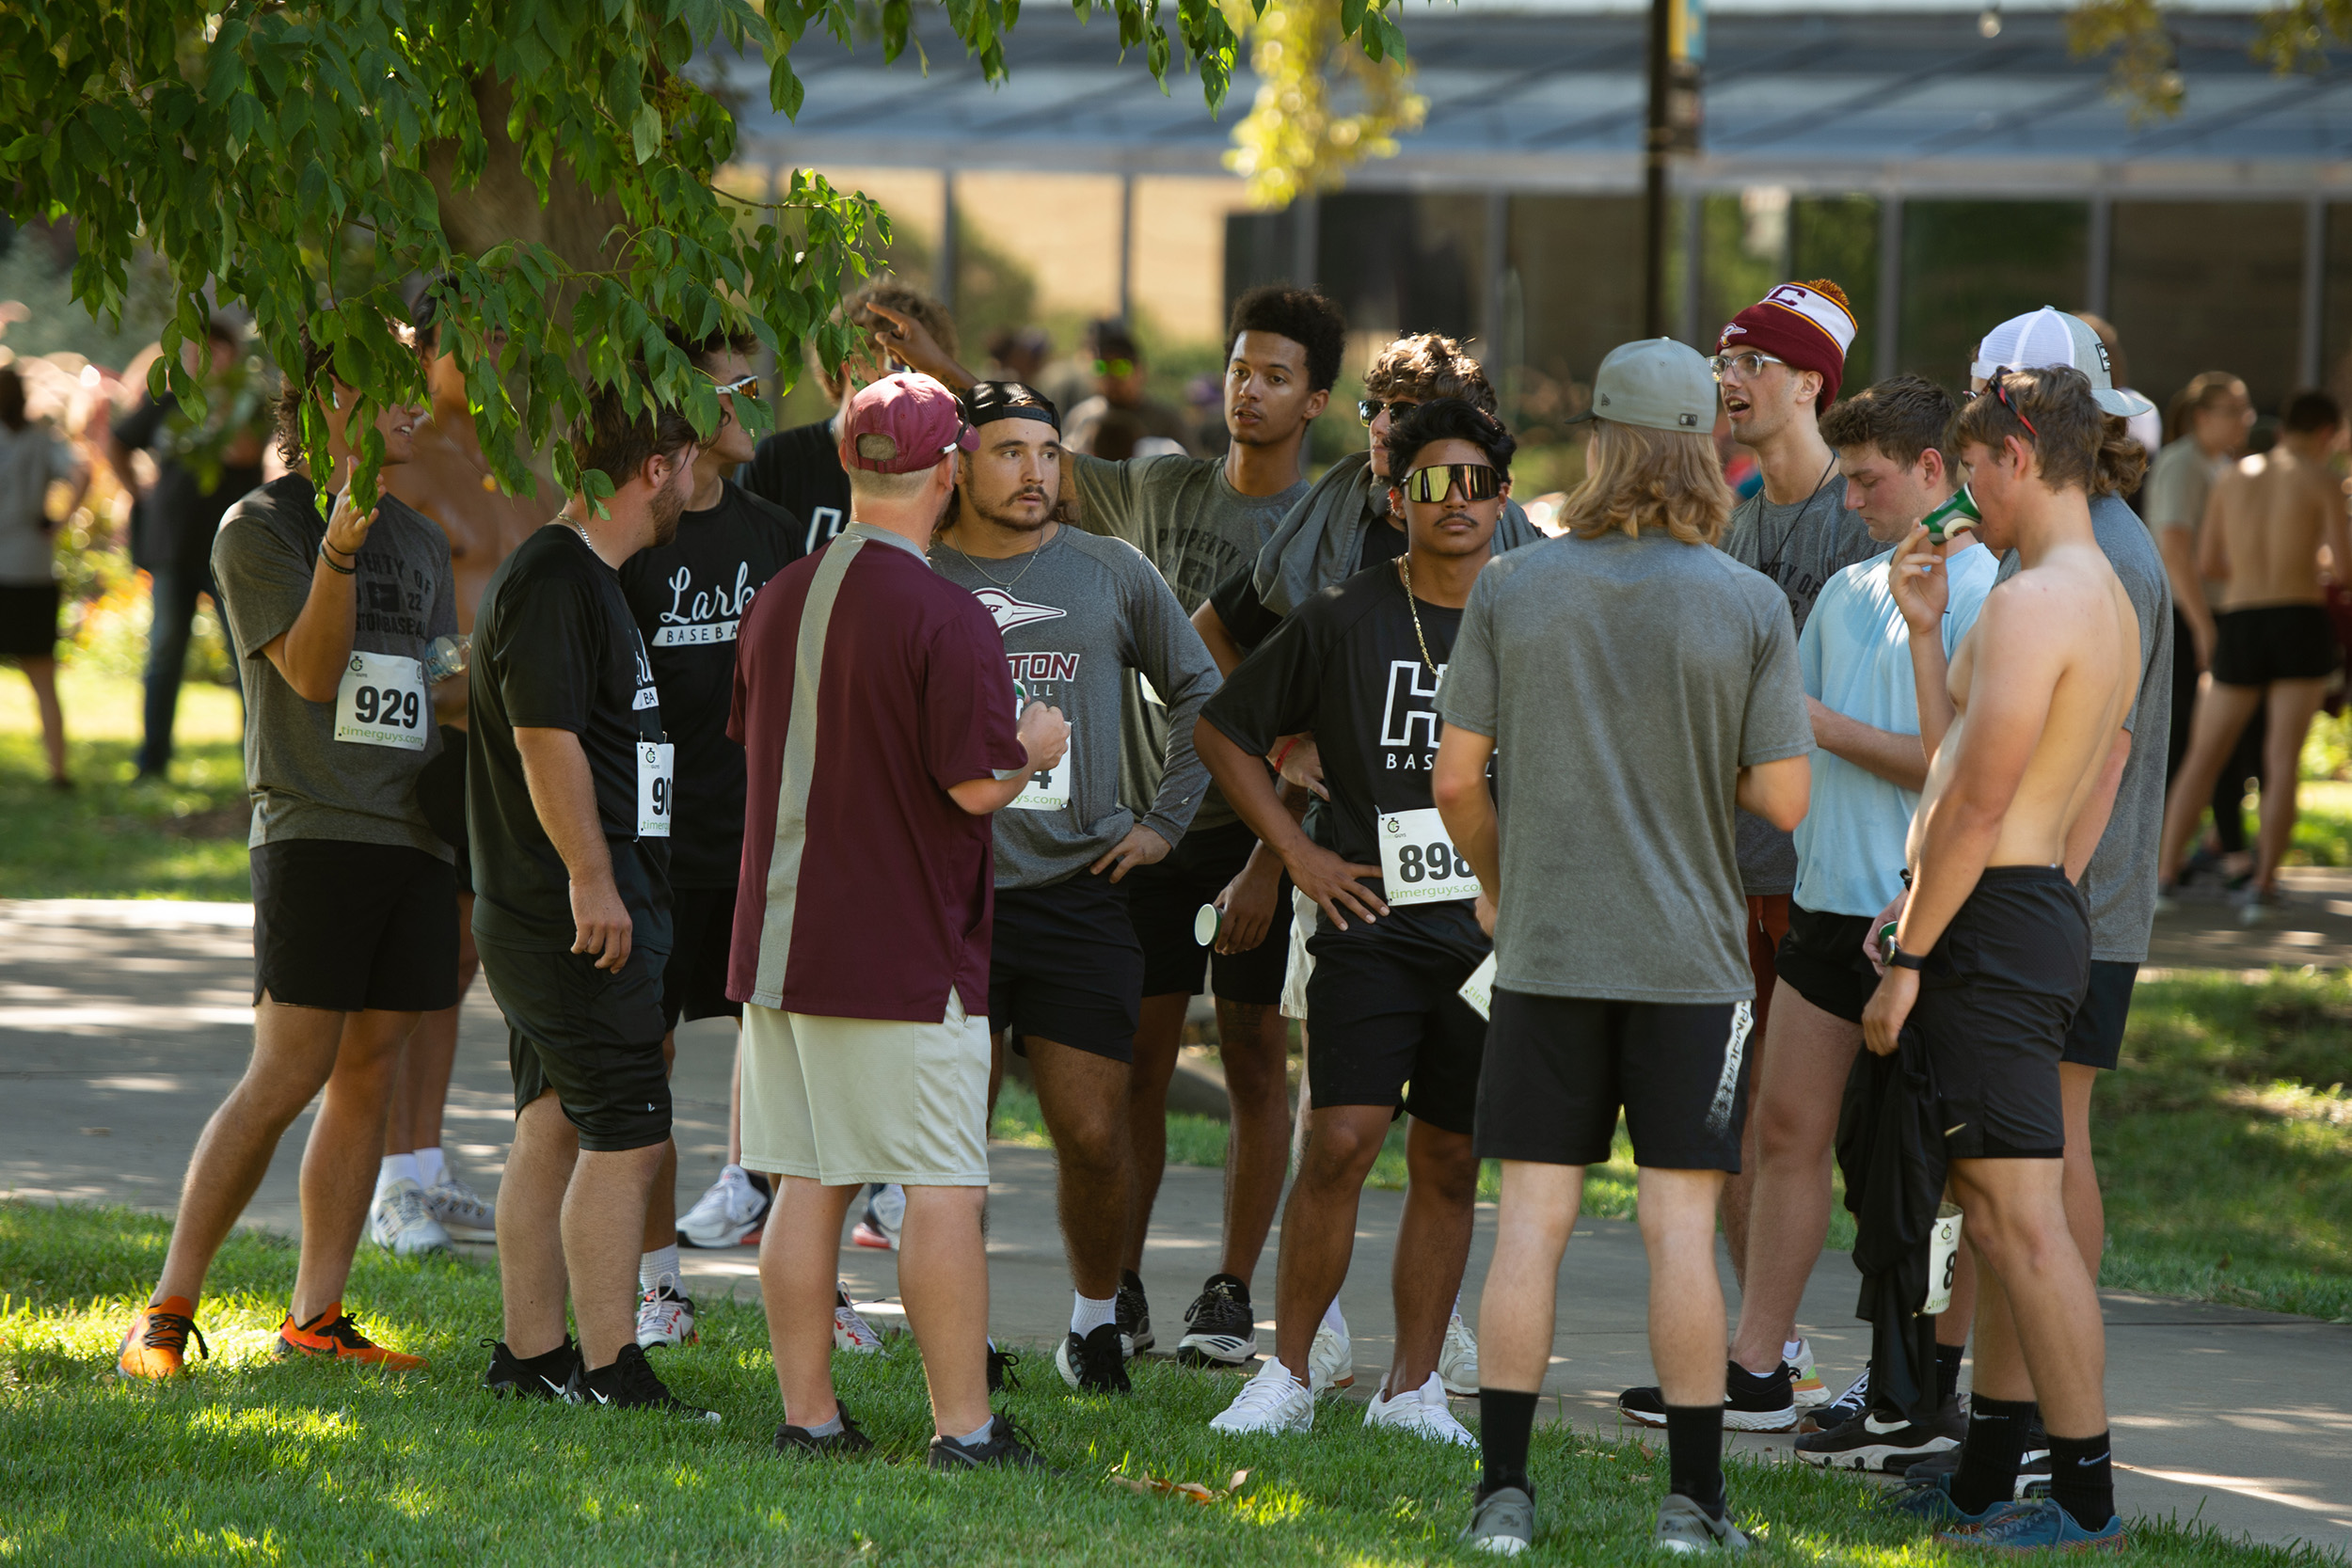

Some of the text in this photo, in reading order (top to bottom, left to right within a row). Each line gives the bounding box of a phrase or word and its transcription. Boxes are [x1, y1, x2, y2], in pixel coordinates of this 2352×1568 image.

[1765, 285, 1806, 307] C
[660, 561, 767, 625] Lark
[355, 686, 420, 729] 929
[341, 725, 422, 744] timerguys.com
[1399, 842, 1476, 882] 898
[1469, 985, 1490, 1012] tim
